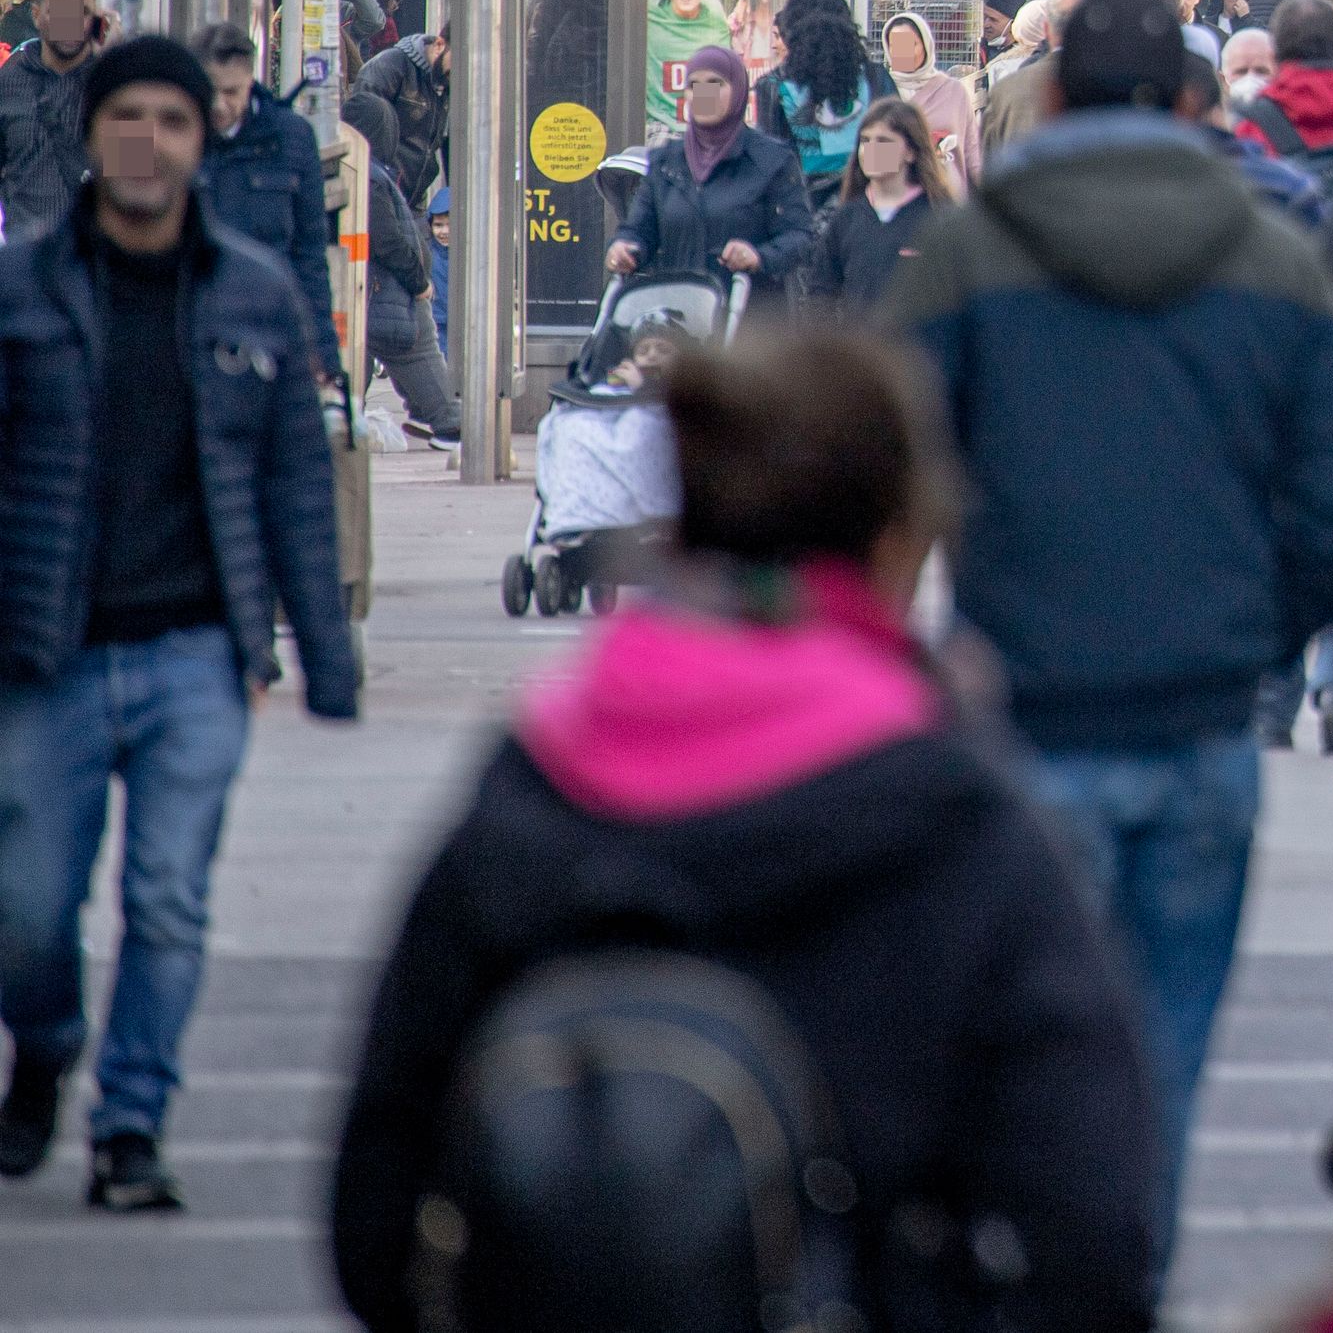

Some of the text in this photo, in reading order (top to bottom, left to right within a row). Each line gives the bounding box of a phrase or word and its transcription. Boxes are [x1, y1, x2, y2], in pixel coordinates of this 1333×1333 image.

[553, 117, 581, 125] Danke,
[567, 133, 587, 142] jetzt
[541, 141, 594, 150] unterstützen.
[544, 154, 590, 162] Bleiben Sie
[550, 162, 583, 171] gesund!
